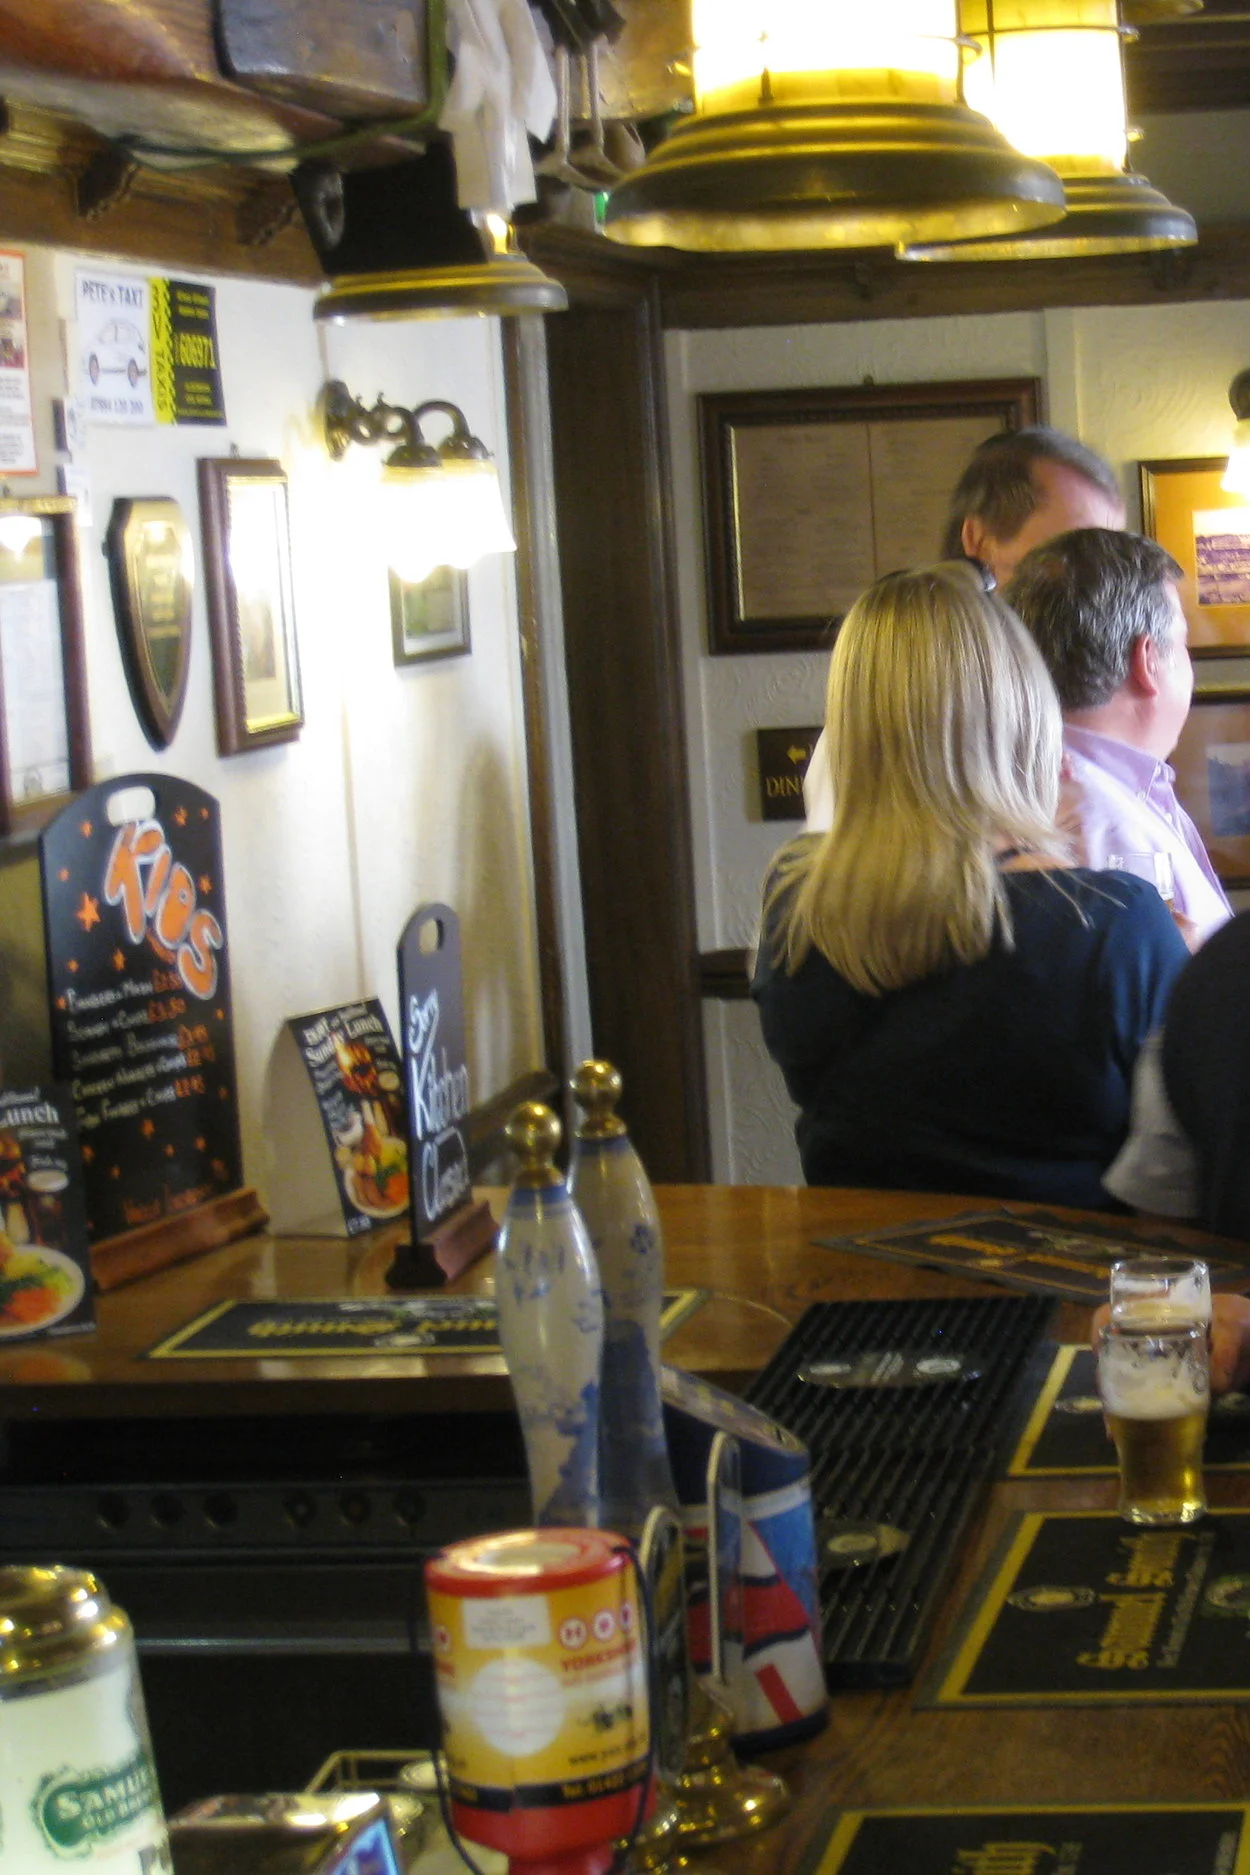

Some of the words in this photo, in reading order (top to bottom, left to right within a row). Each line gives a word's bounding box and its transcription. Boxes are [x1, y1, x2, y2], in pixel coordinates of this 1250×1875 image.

[117, 284, 144, 308] TAXI
[766, 775, 804, 797] DIN
[345, 1014, 384, 1039] Lunch
